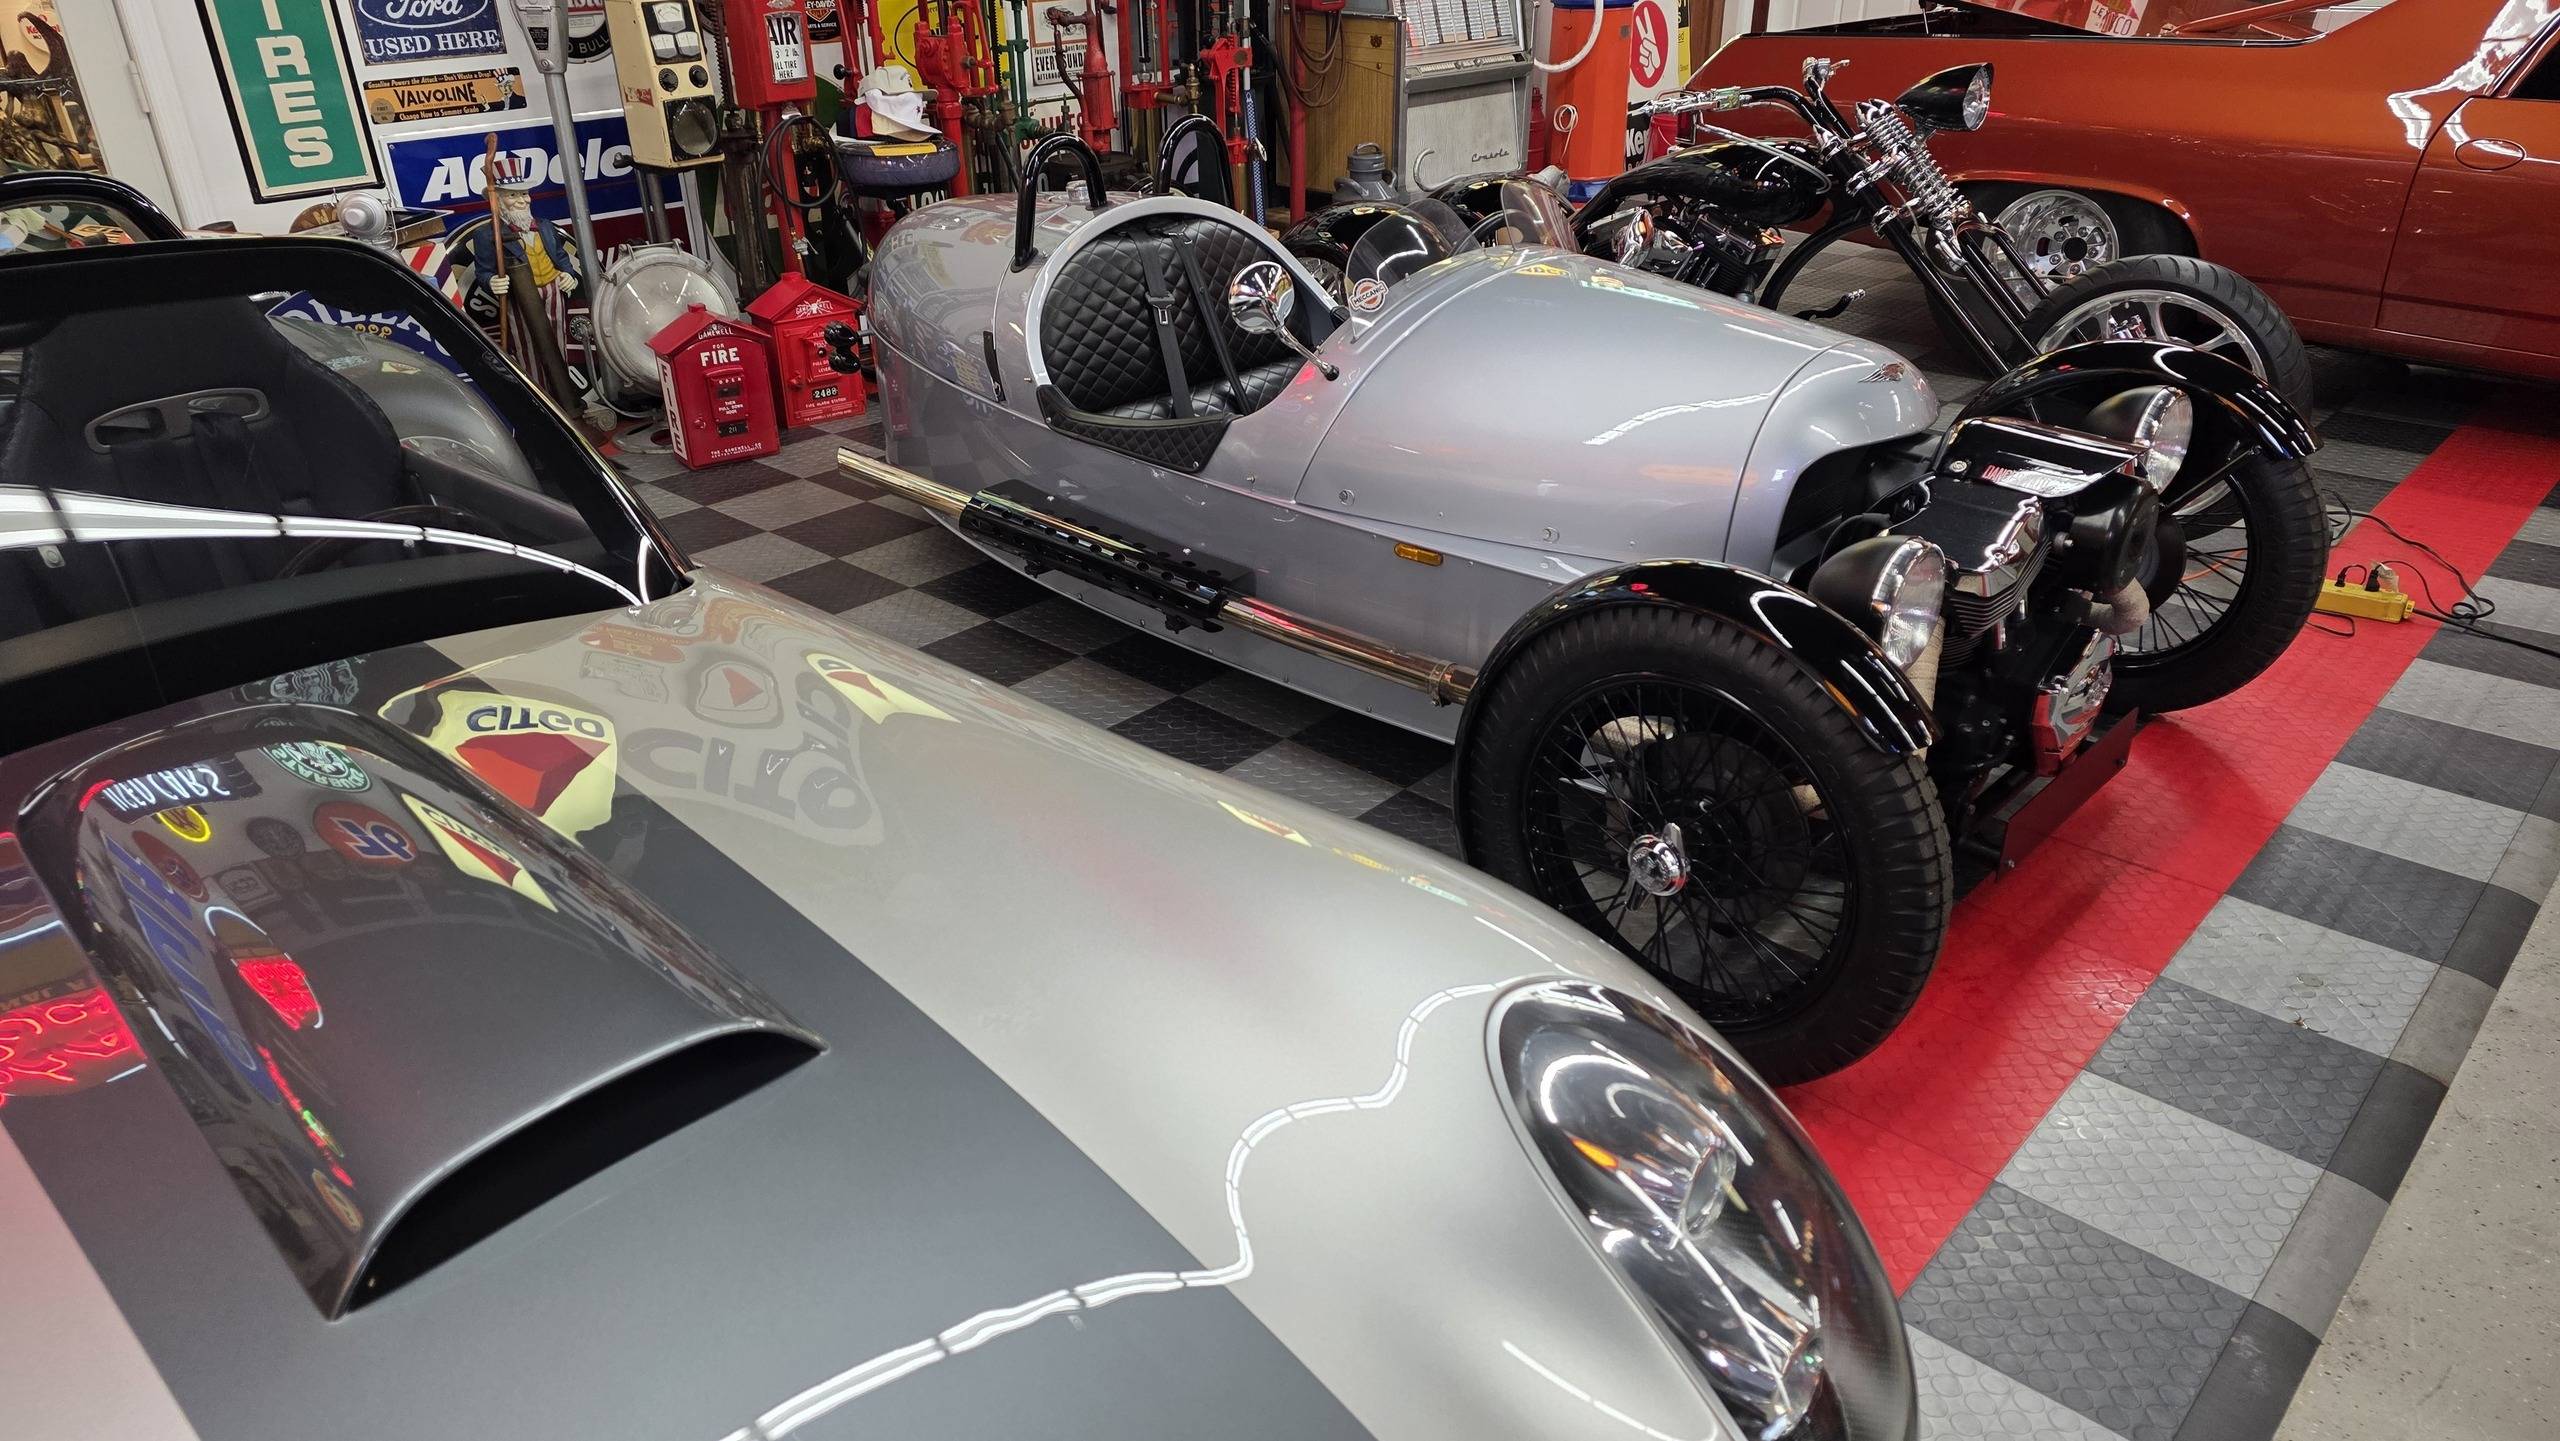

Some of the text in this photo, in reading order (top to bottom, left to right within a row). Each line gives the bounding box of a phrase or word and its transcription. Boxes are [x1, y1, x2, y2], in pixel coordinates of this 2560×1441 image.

[767, 17, 798, 46] AIR
[366, 35, 432, 57] USED
[435, 29, 500, 51] HERE
[785, 59, 797, 70] TIRE
[1063, 51, 1086, 70] SUND
[411, 77, 421, 85] the
[779, 69, 794, 79] HERE
[256, 0, 334, 168] IRES
[393, 81, 478, 109] VALVOLINE
[698, 327, 734, 340] GAMEWELL
[700, 347, 740, 367] FIRE
[814, 387, 837, 399] 2488
[660, 363, 683, 454] FIRE
